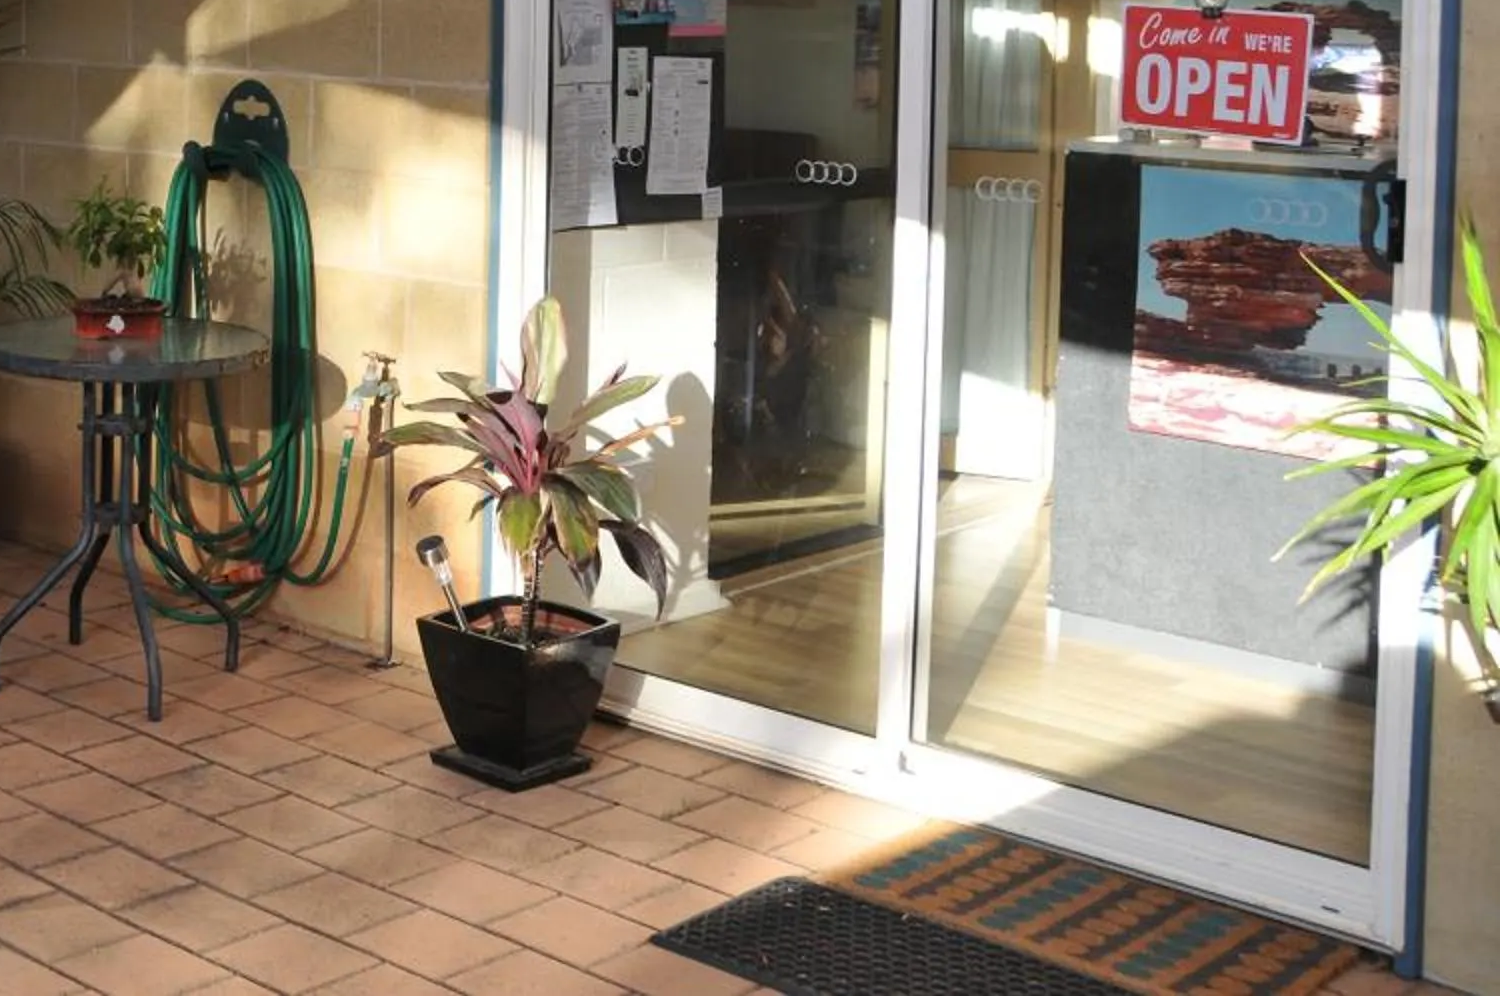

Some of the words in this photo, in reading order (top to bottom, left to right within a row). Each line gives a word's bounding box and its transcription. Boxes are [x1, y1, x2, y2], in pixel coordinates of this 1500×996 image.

[1139, 11, 1203, 50] Come
[1207, 18, 1232, 46] in
[1243, 31, 1293, 54] WE'RE
[1135, 52, 1292, 128] OPEN
